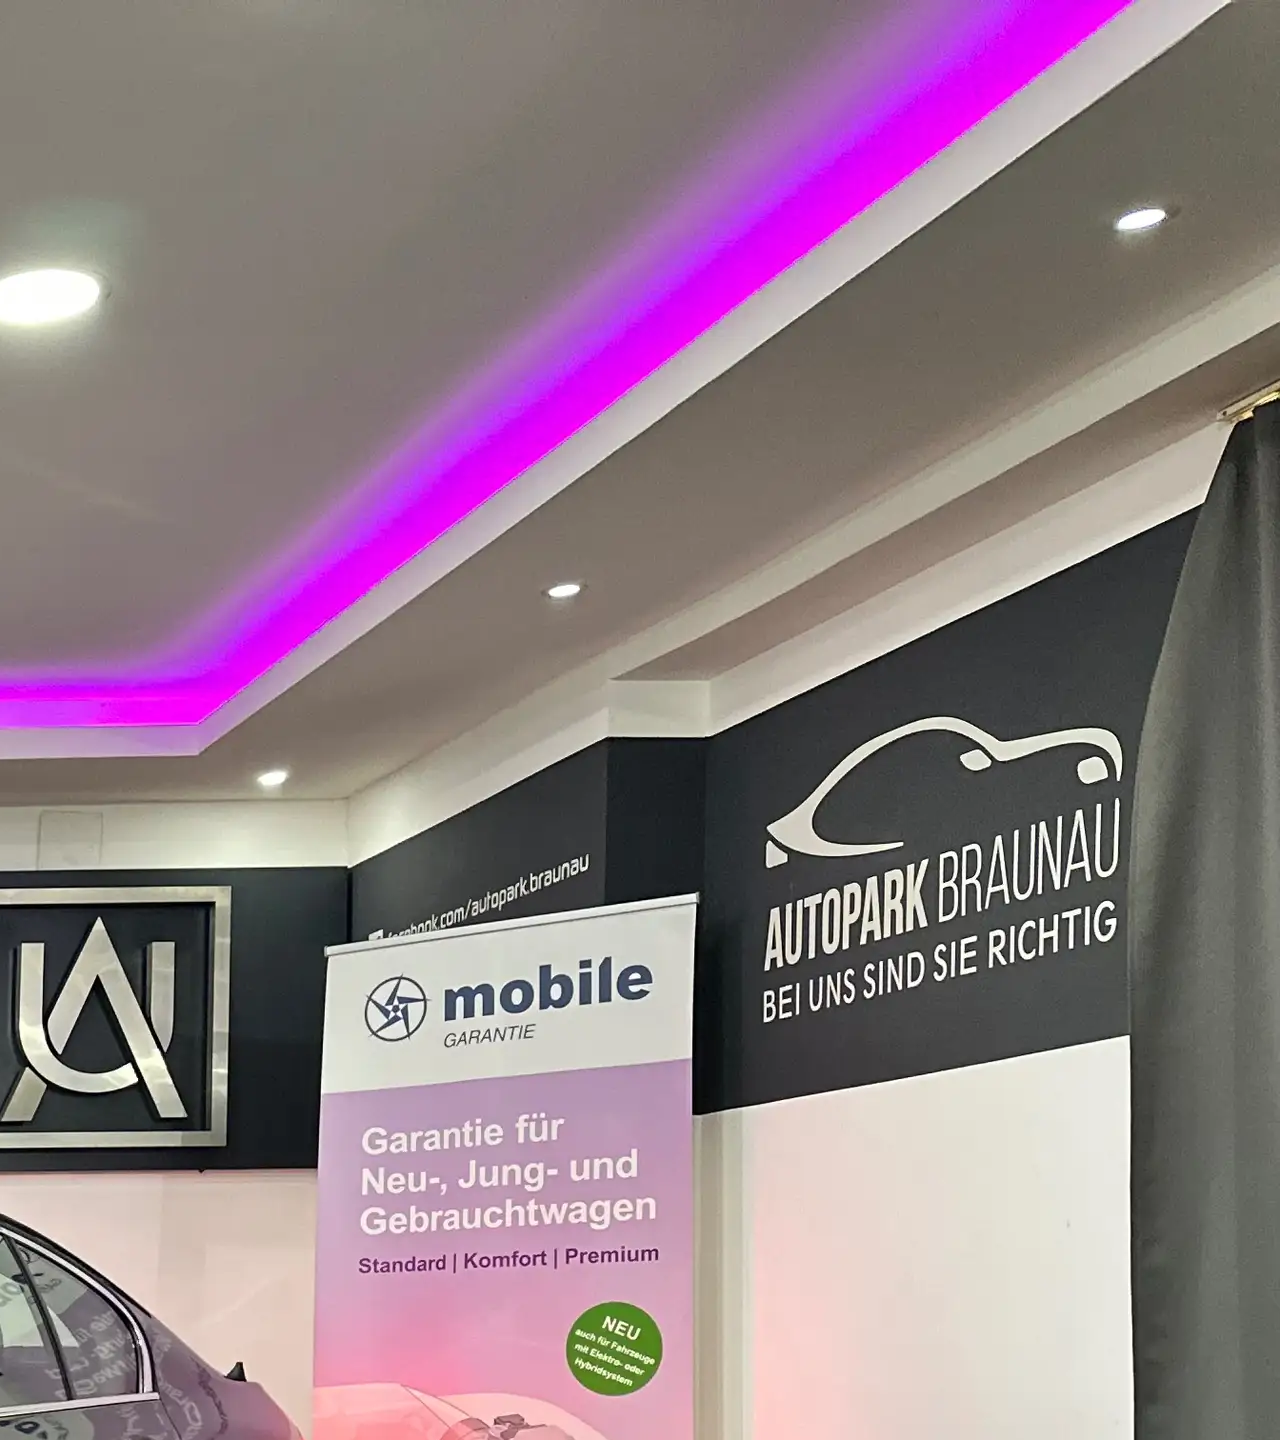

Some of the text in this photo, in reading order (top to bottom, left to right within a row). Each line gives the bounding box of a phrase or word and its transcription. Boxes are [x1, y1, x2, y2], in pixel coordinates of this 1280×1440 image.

[764, 798, 1120, 971] AUTOPARK BRAUNAU
[764, 901, 1117, 1022] BEI UNS SIND SIE RICHTIG
[444, 956, 653, 1022] mobile
[443, 1023, 536, 1048] GARANTIE
[361, 1113, 564, 1156] Garantie für
[361, 1149, 639, 1197] Neu-, Jung- und
[360, 1196, 657, 1236] Gebrauchtwagen
[358, 1254, 446, 1274] Standard
[464, 1250, 547, 1270] Komfort
[565, 1246, 659, 1265] Premium
[575, 1329, 655, 1365] auch für Fahrzeuge
[602, 1316, 641, 1340] NEU
[574, 1343, 645, 1376] mit Elektro- oder
[574, 1357, 633, 1386] Hybridsystem
